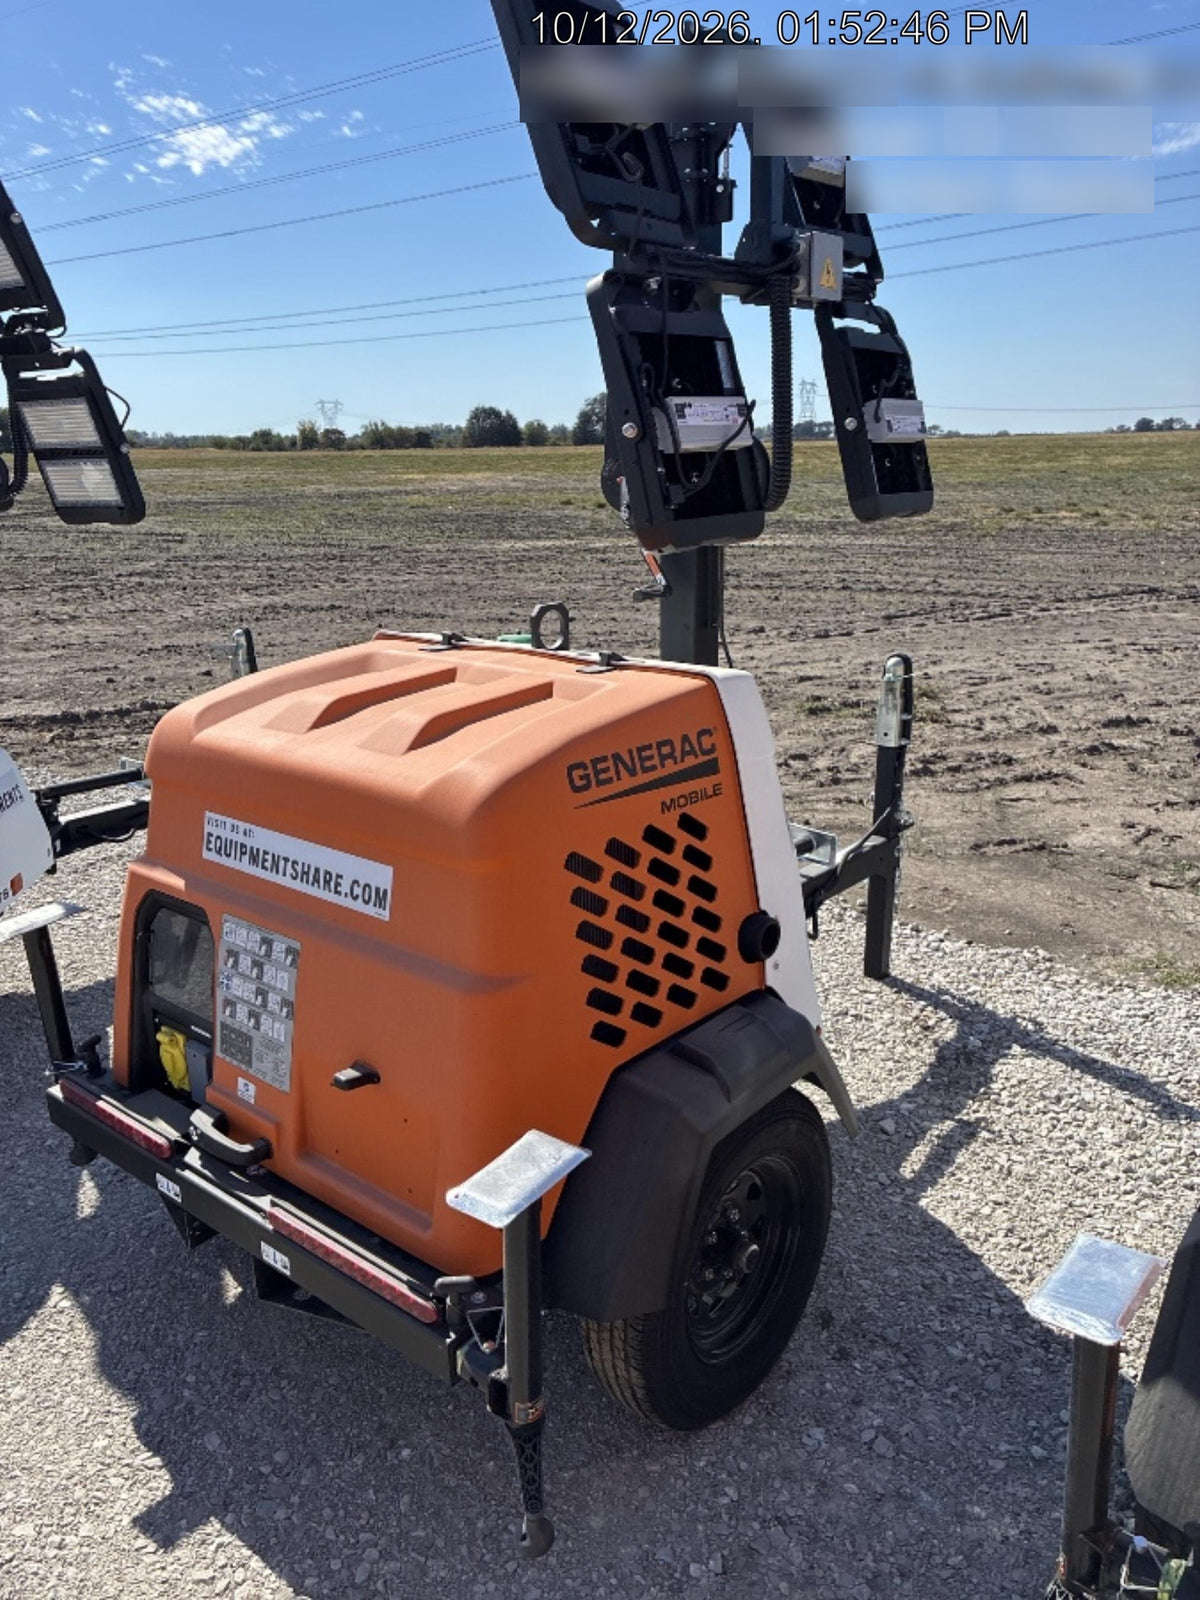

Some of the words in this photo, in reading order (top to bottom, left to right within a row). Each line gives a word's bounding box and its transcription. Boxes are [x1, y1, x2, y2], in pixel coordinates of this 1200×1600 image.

[567, 728, 717, 793] GENERAC
[661, 783, 723, 814] MOBILE
[205, 831, 388, 911] EQUIPMENTSHARE.COM
